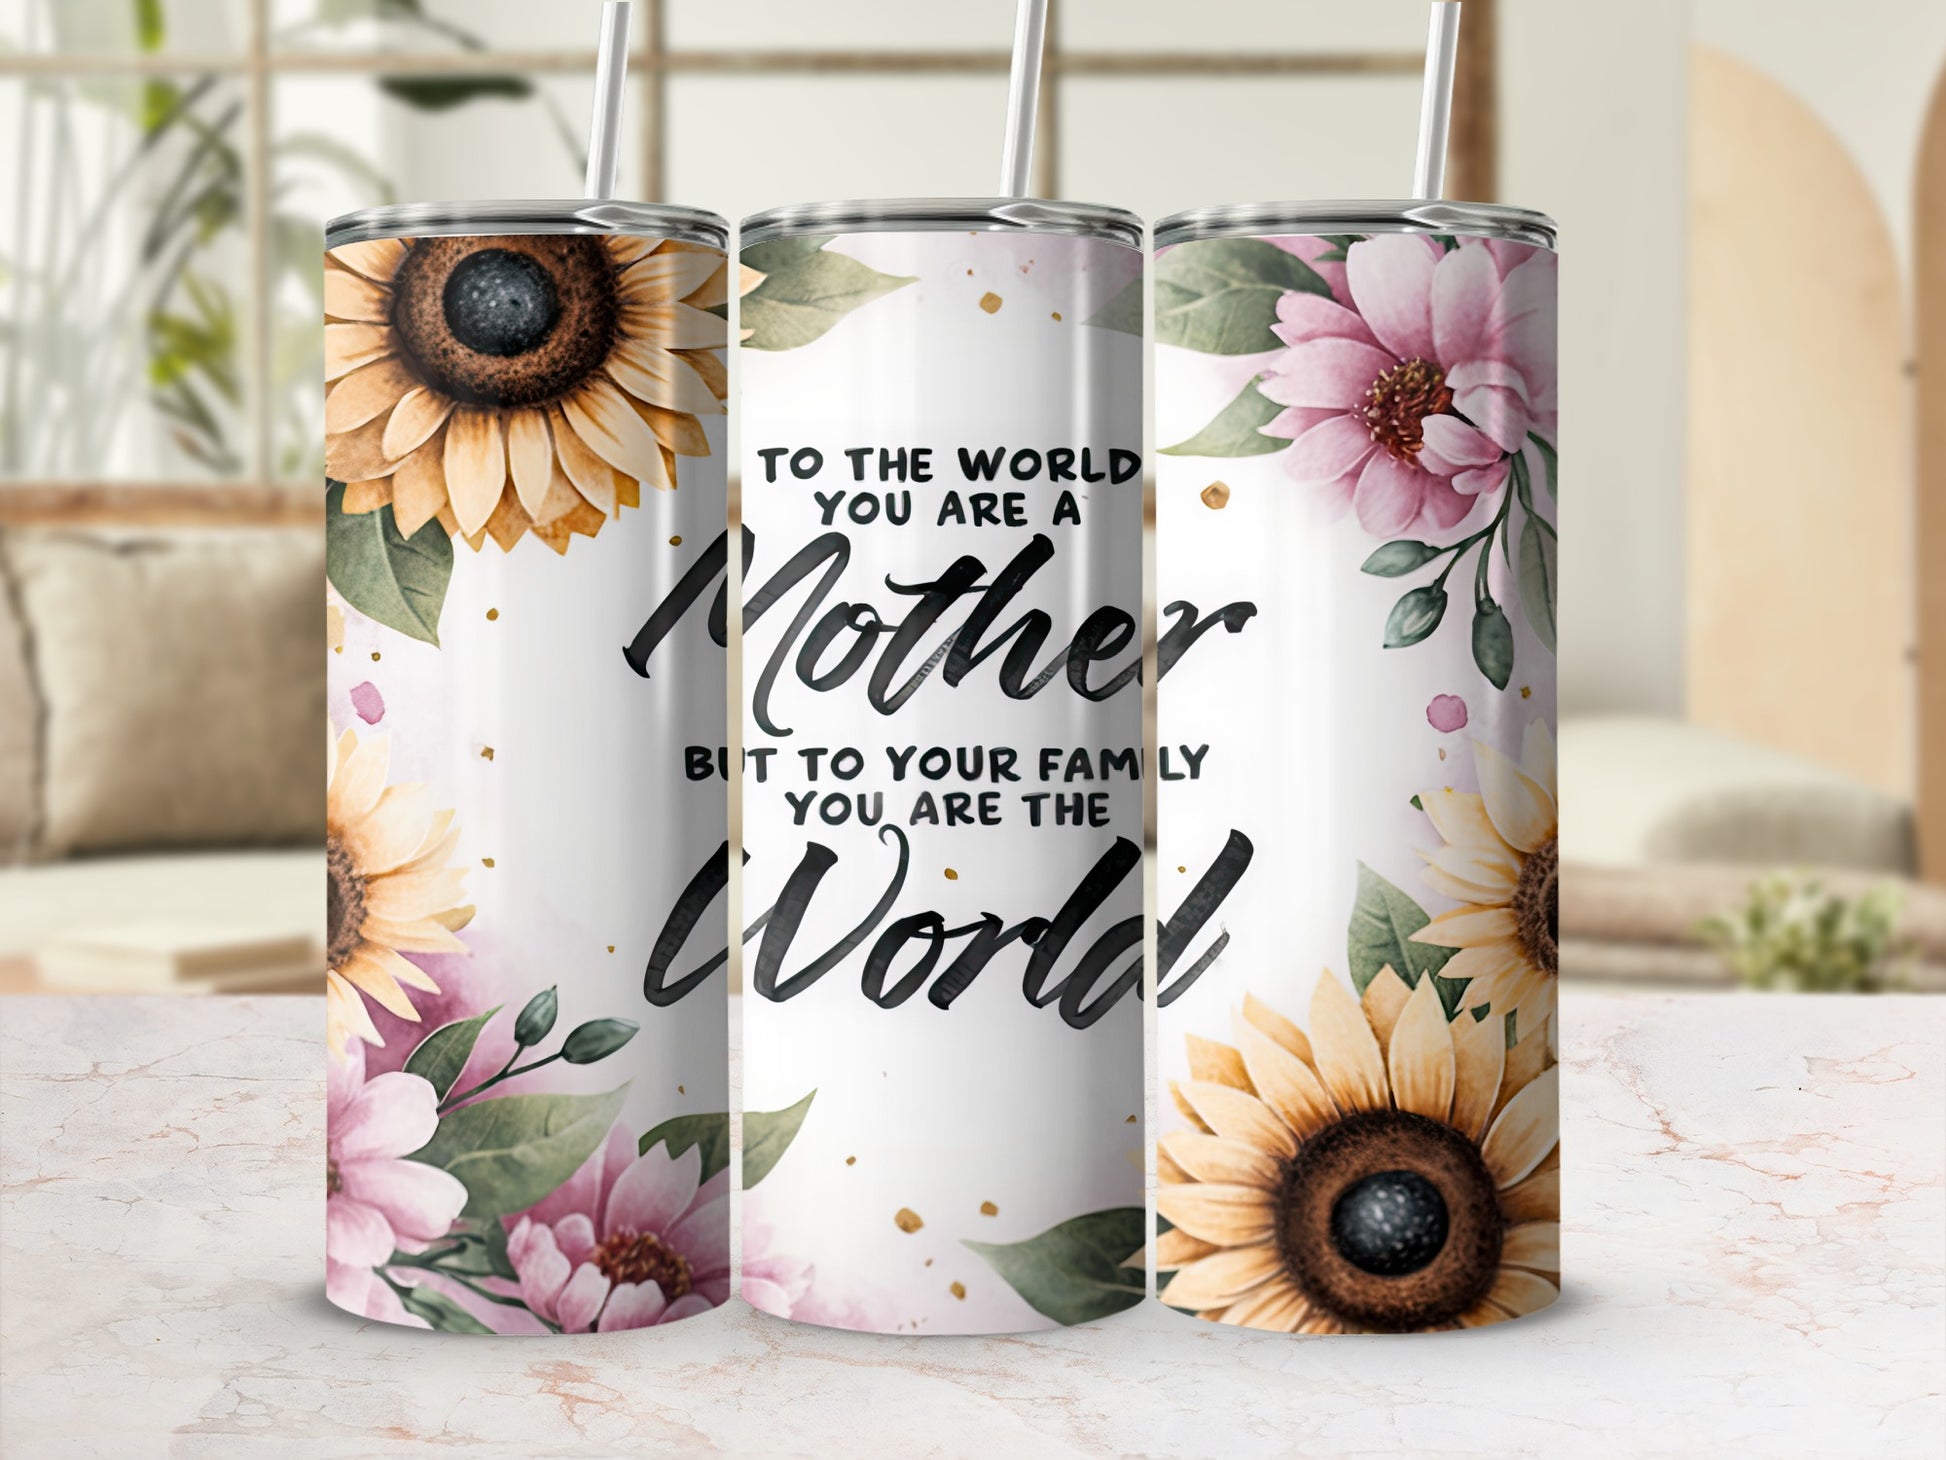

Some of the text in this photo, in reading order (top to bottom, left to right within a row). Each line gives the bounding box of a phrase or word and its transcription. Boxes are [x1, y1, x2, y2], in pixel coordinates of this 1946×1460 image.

[758, 447, 1142, 484] TO THE WORLD
[814, 490, 1081, 526] YOU ARE A
[622, 523, 1258, 737] Mother
[798, 747, 864, 781] TO
[886, 745, 1022, 783] YOUR
[1039, 744, 1209, 783] FAMLY
[784, 791, 1110, 827] YOU ARE THE
[644, 824, 1253, 1030] World
